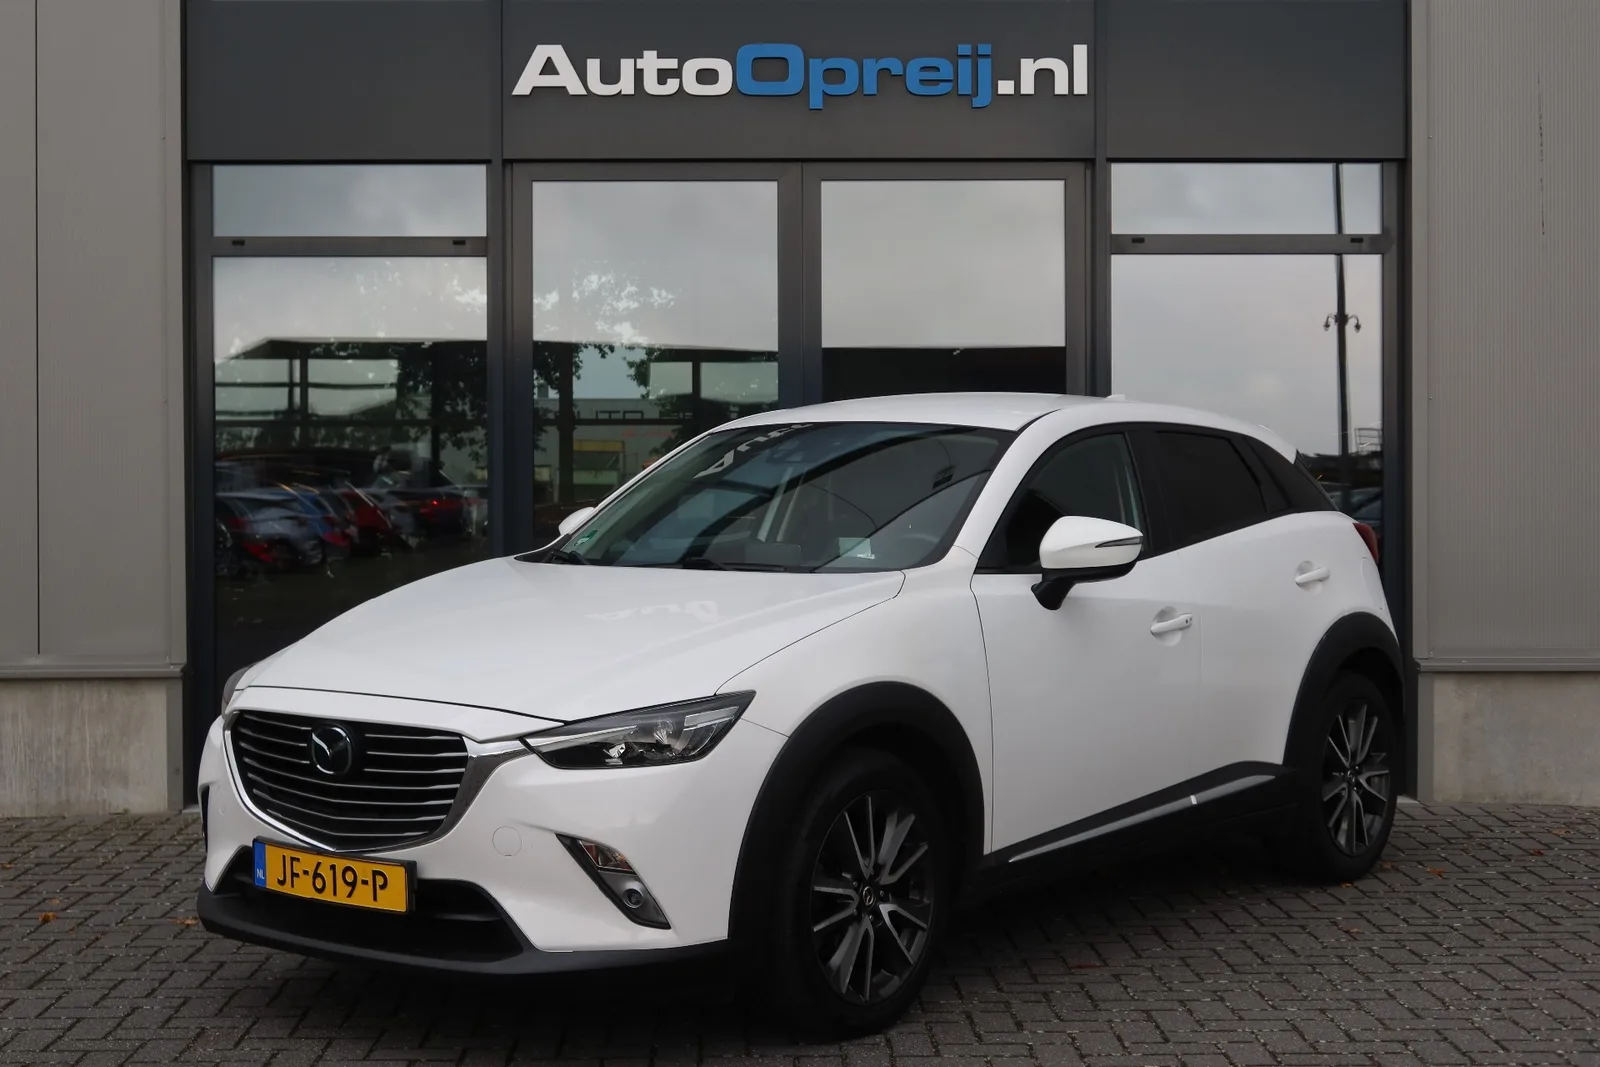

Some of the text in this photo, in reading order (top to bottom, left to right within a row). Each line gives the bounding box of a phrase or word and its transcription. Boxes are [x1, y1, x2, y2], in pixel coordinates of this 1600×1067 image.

[511, 43, 1088, 110] AutoOpreij.nl
[256, 868, 265, 880] NL
[277, 854, 389, 902] JF-619-P
